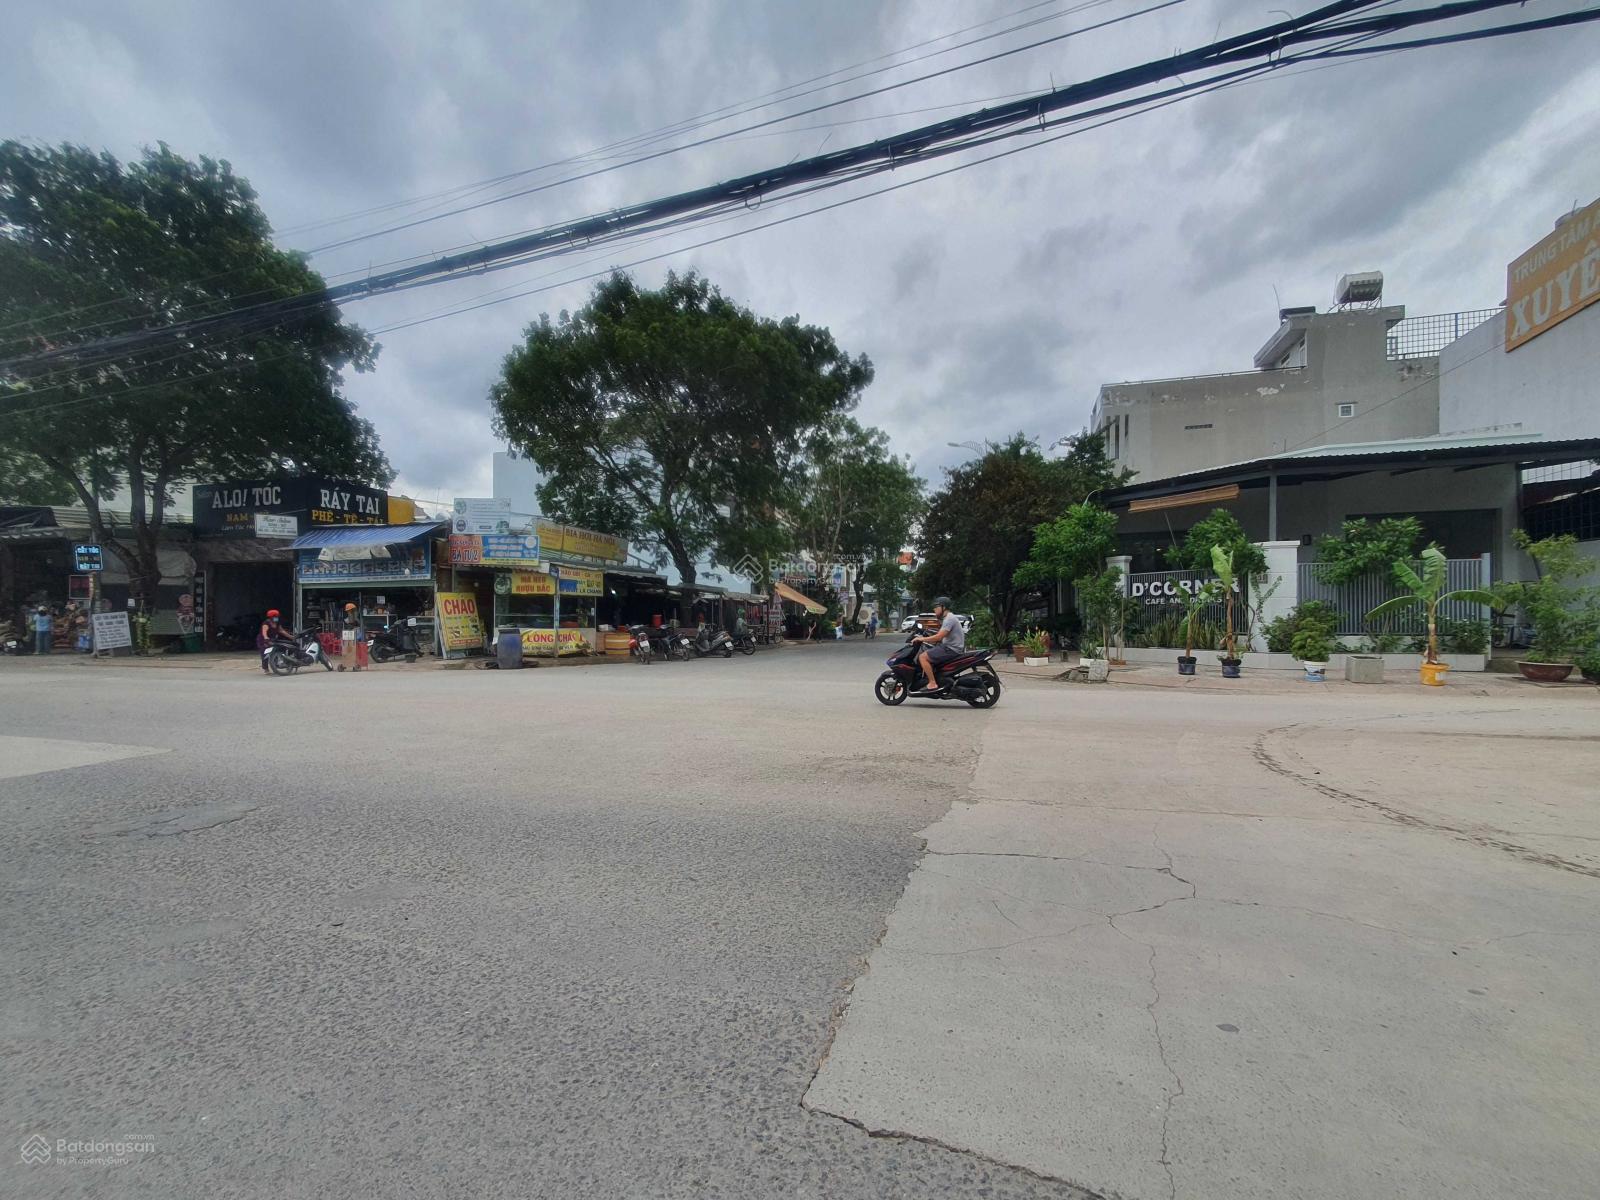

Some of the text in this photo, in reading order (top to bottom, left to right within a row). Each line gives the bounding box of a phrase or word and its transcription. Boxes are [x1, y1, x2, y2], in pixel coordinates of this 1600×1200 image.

[1514, 242, 1557, 283] TRUNG
[1559, 216, 1591, 253] TÂM
[1511, 239, 1600, 342] XUYÊ
[212, 482, 281, 509] ALO! TÓC
[320, 486, 380, 515] RÁY TAI
[565, 528, 578, 539] BIA
[1169, 597, 1184, 605] AN
